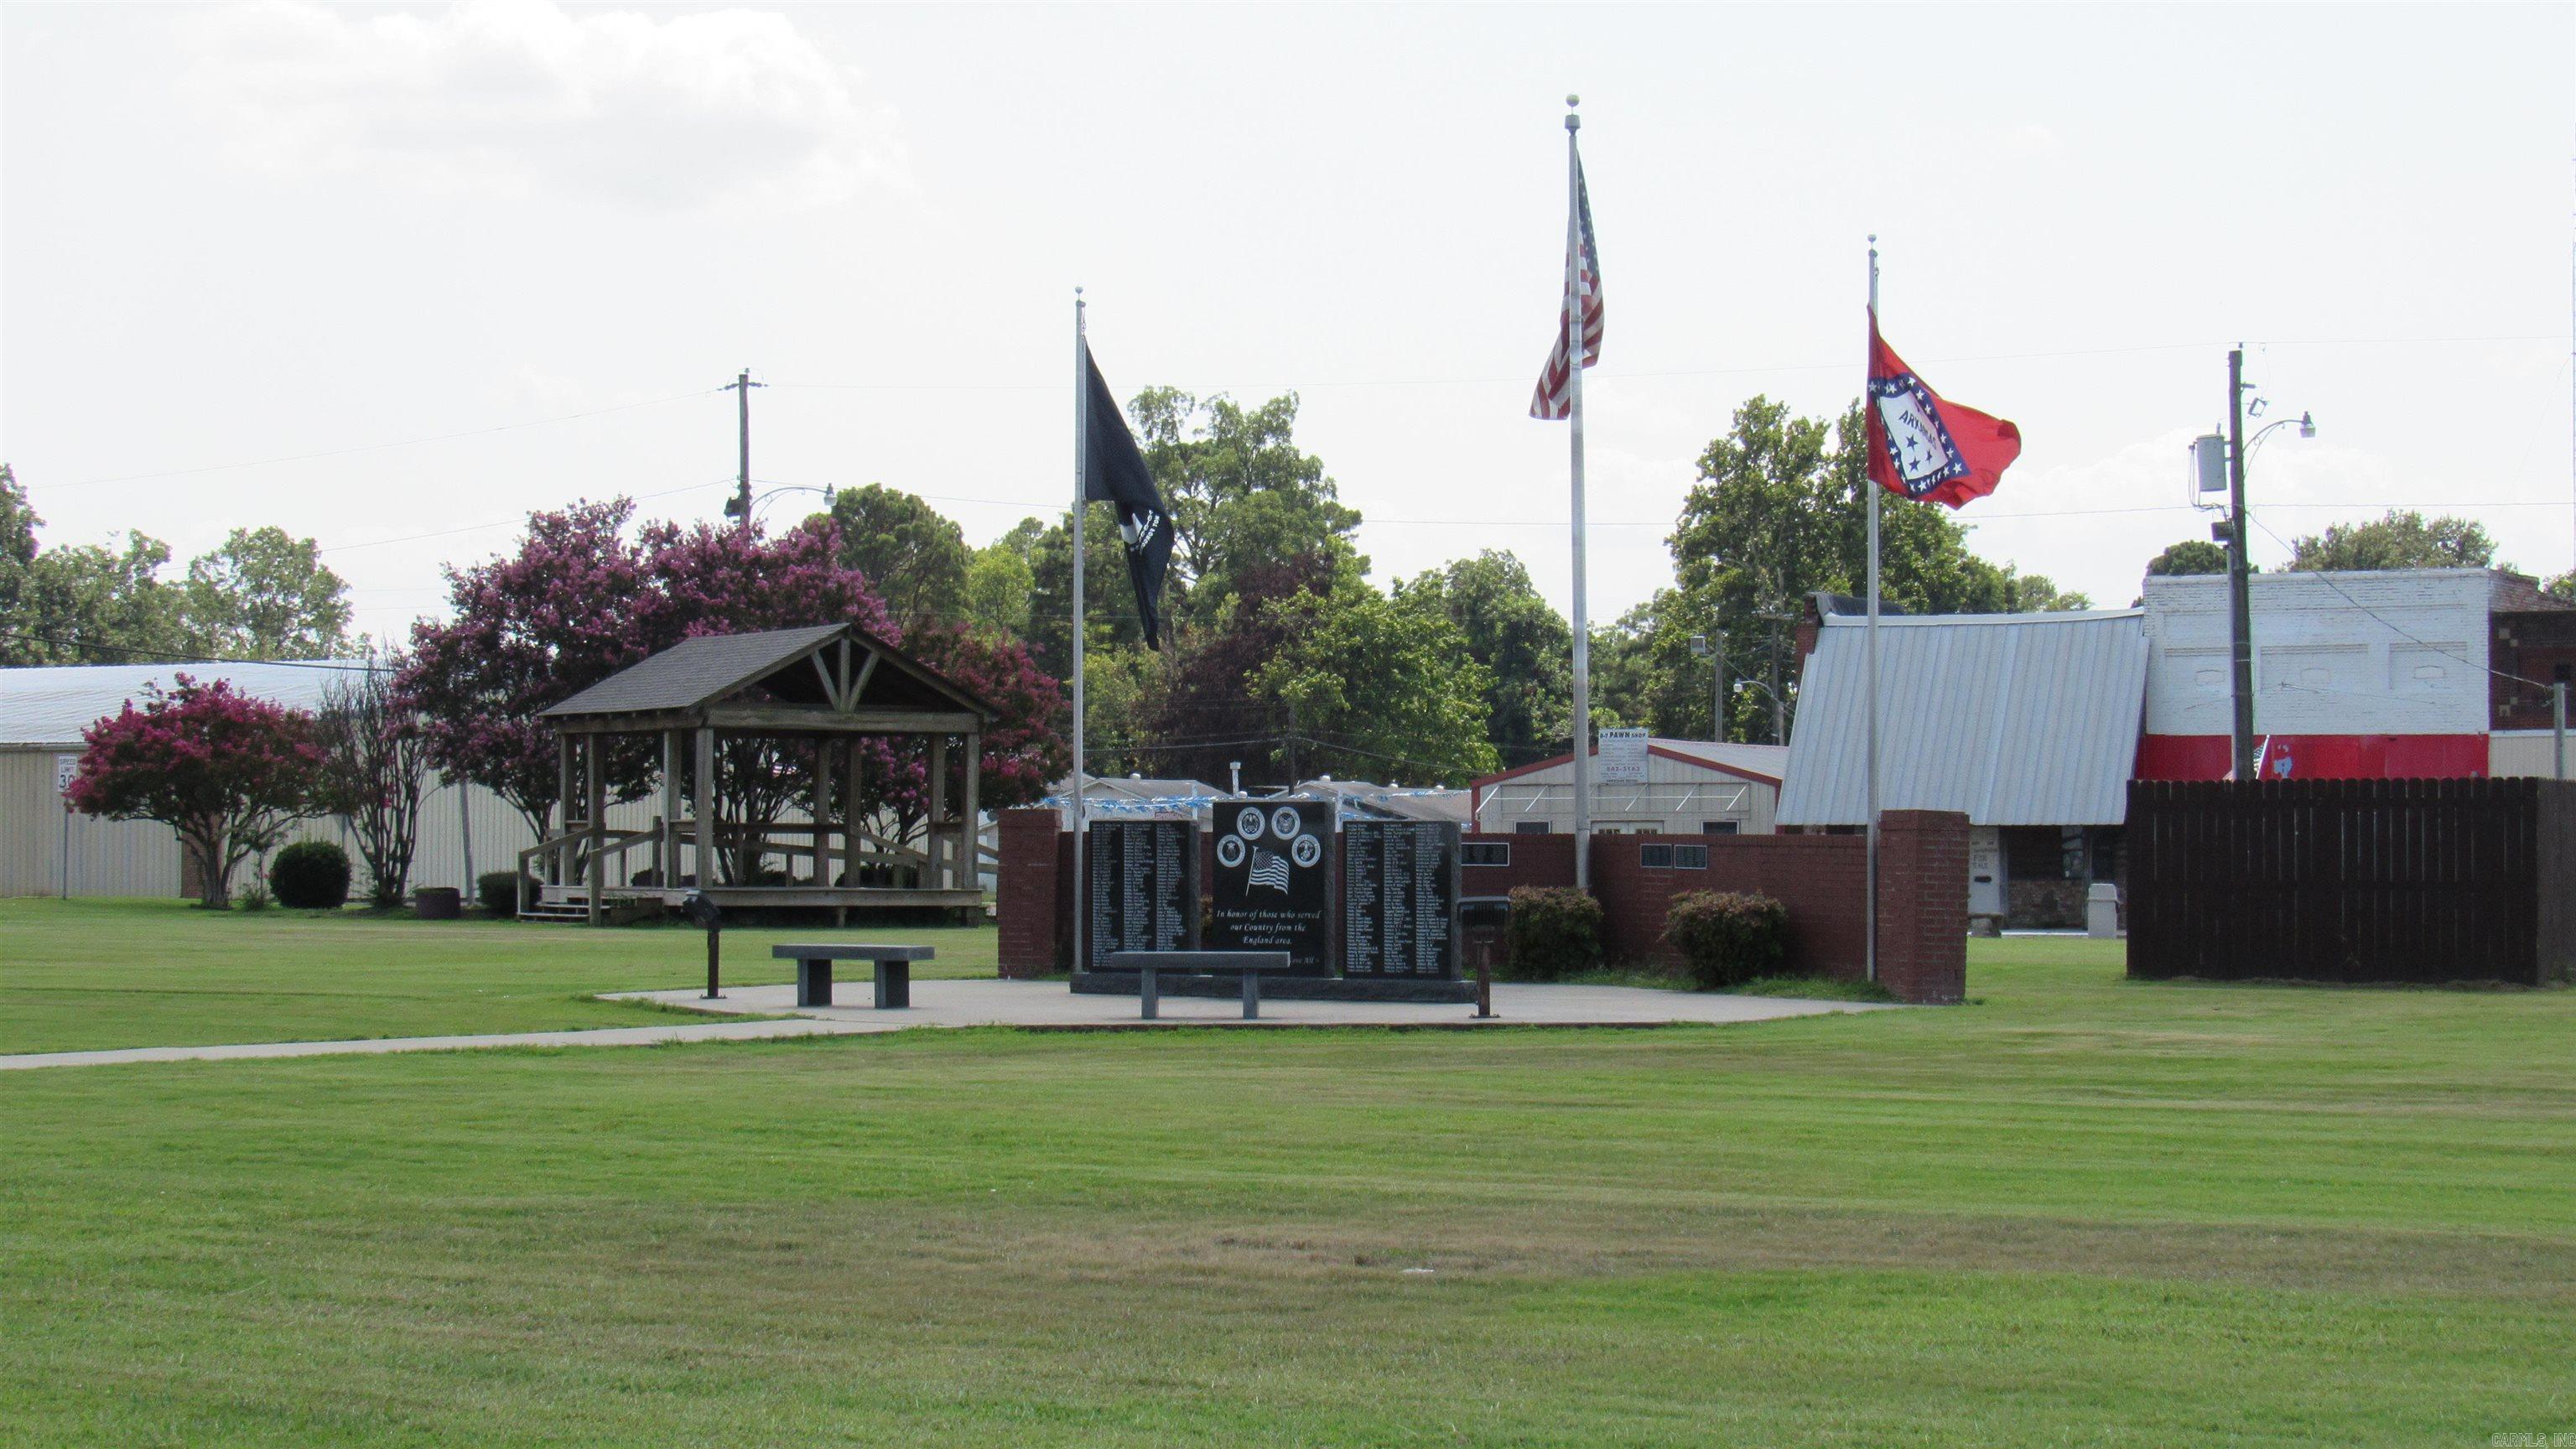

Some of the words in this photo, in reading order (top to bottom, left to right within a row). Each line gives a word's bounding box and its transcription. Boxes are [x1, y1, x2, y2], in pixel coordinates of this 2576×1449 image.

[1227, 909, 1248, 917] honor
[1249, 909, 1258, 921] of
[1259, 909, 1277, 918] those
[1280, 910, 1296, 918] who
[1297, 910, 1322, 919] served
[1244, 923, 1274, 934] Country
[1274, 922, 1292, 934] from
[1294, 923, 1306, 932] the
[1244, 935, 1275, 946] England
